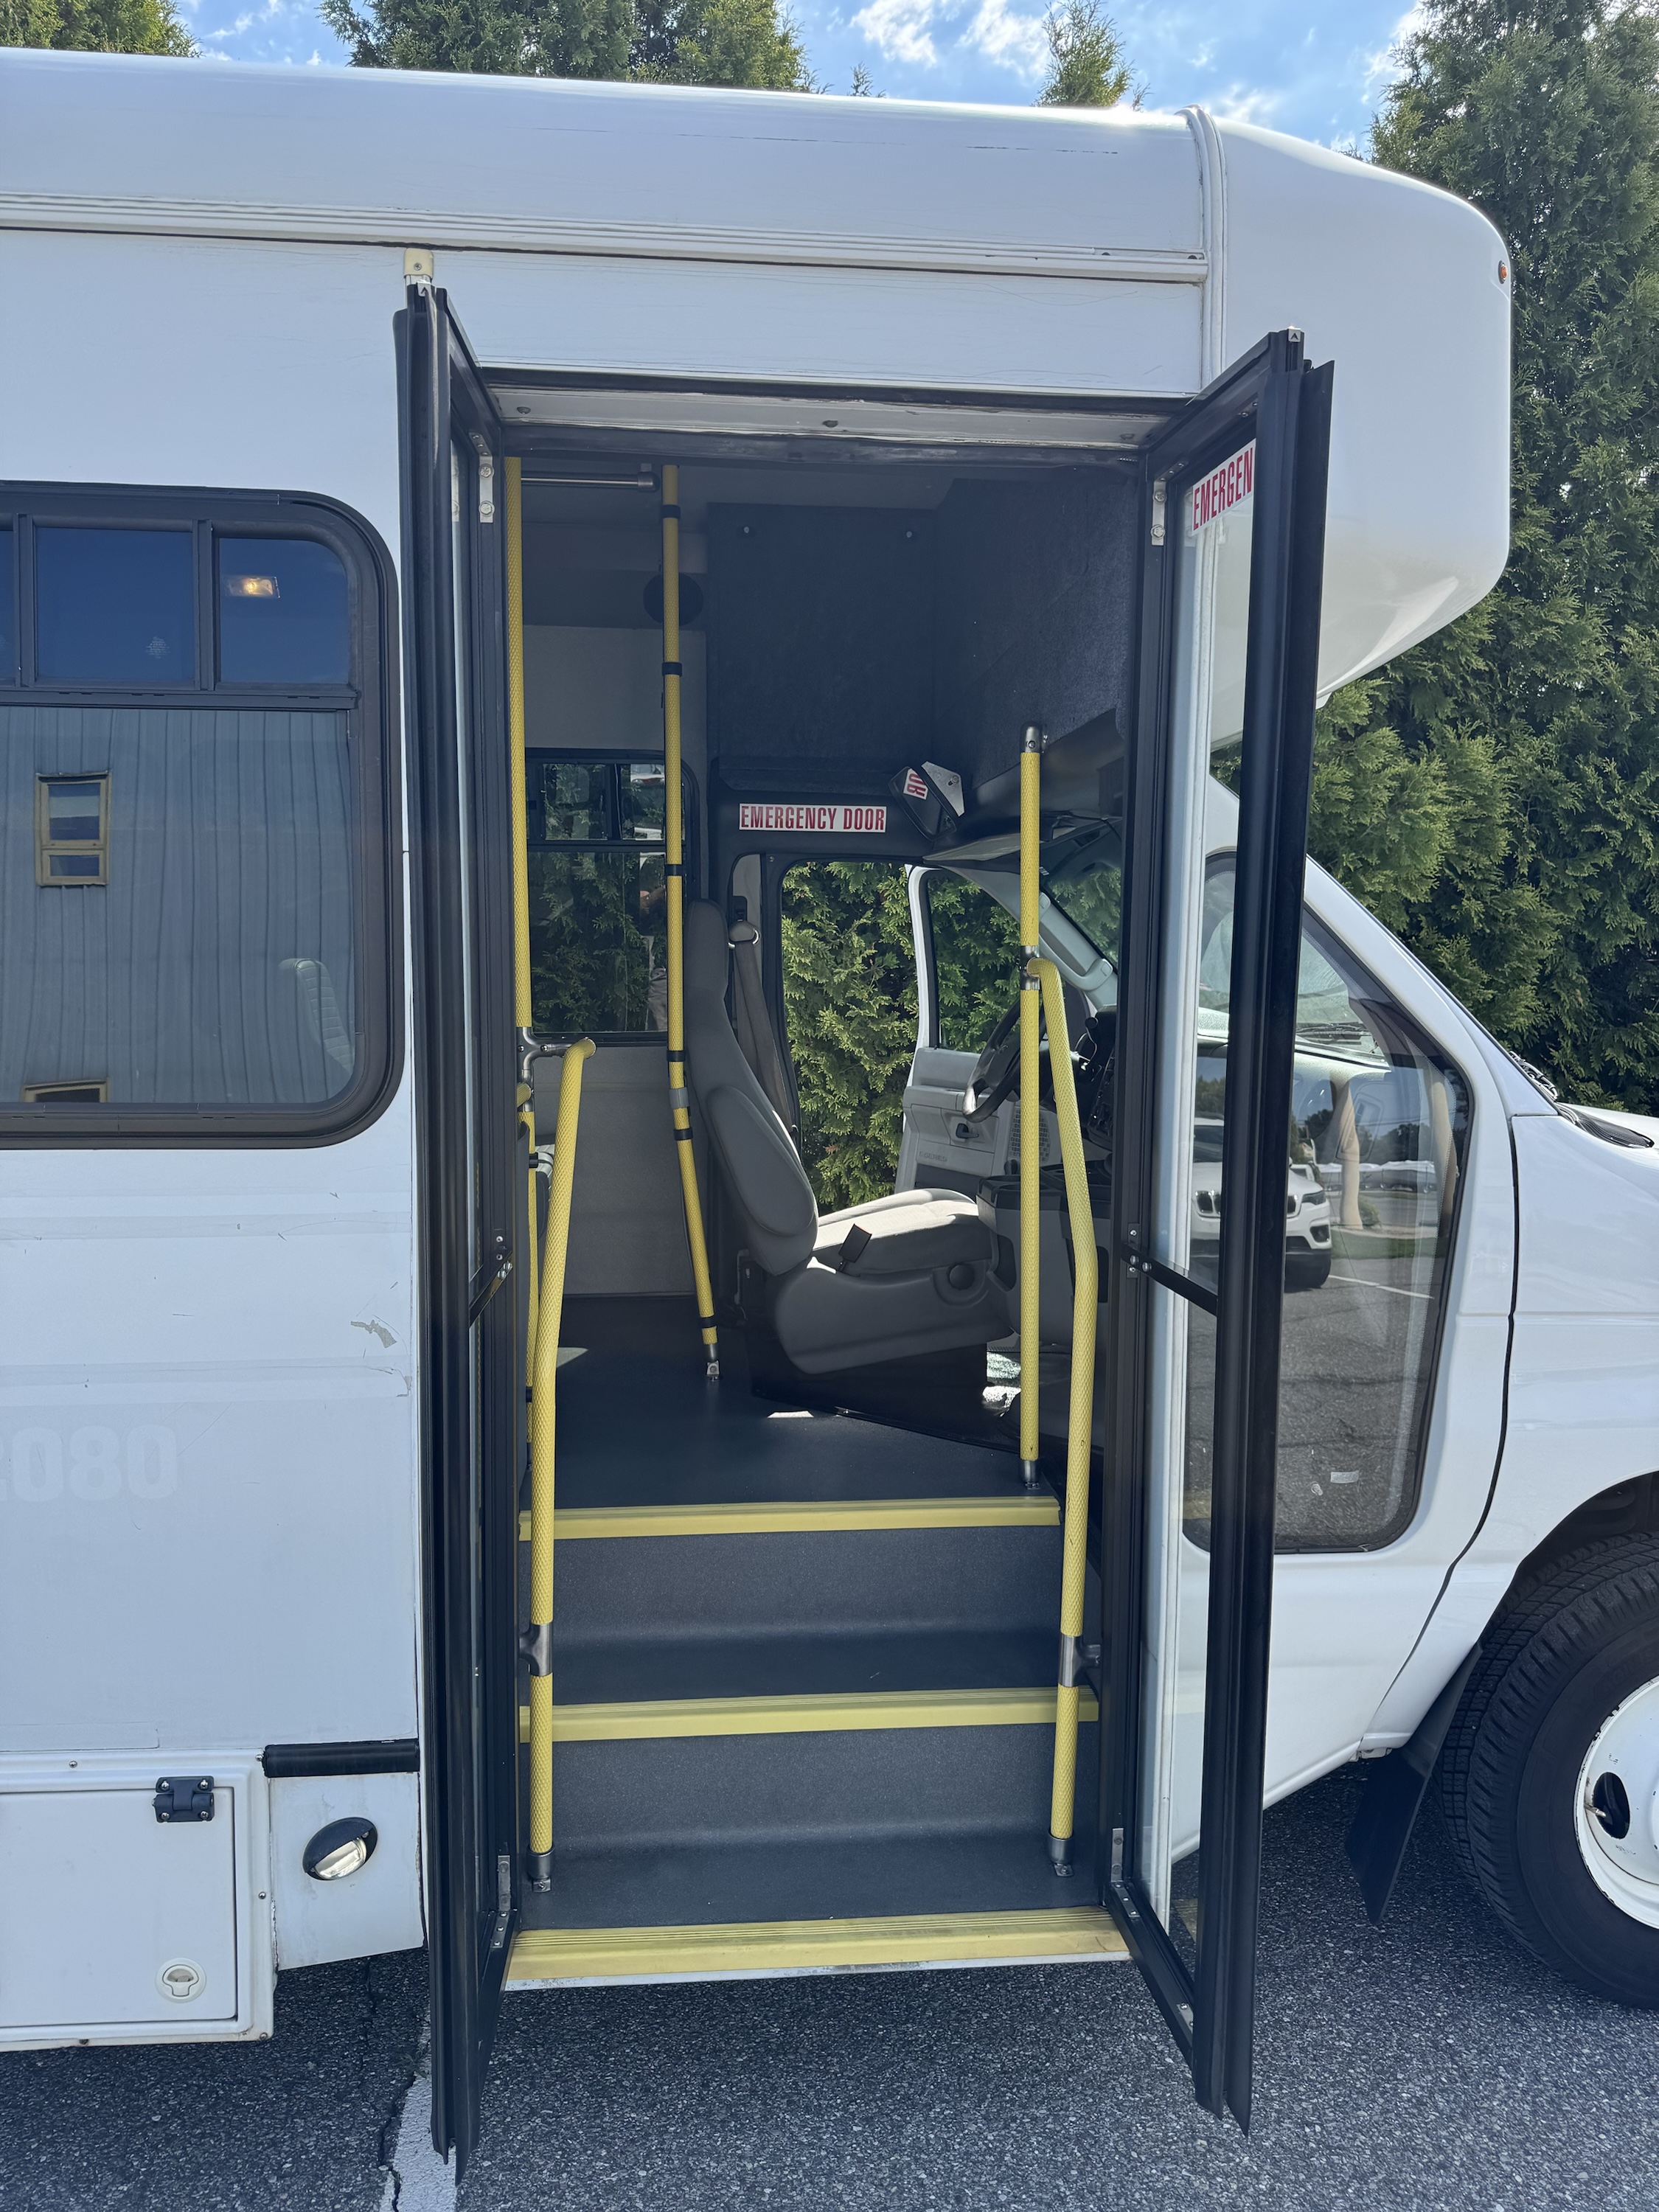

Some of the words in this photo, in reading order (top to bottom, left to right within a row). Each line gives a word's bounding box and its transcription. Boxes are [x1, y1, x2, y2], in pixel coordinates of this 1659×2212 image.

[1193, 447, 1253, 531] EMERGEN
[741, 805, 837, 830] EMERGENCY
[843, 807, 884, 831] DOOR
[0, 1424, 178, 1503] 080
